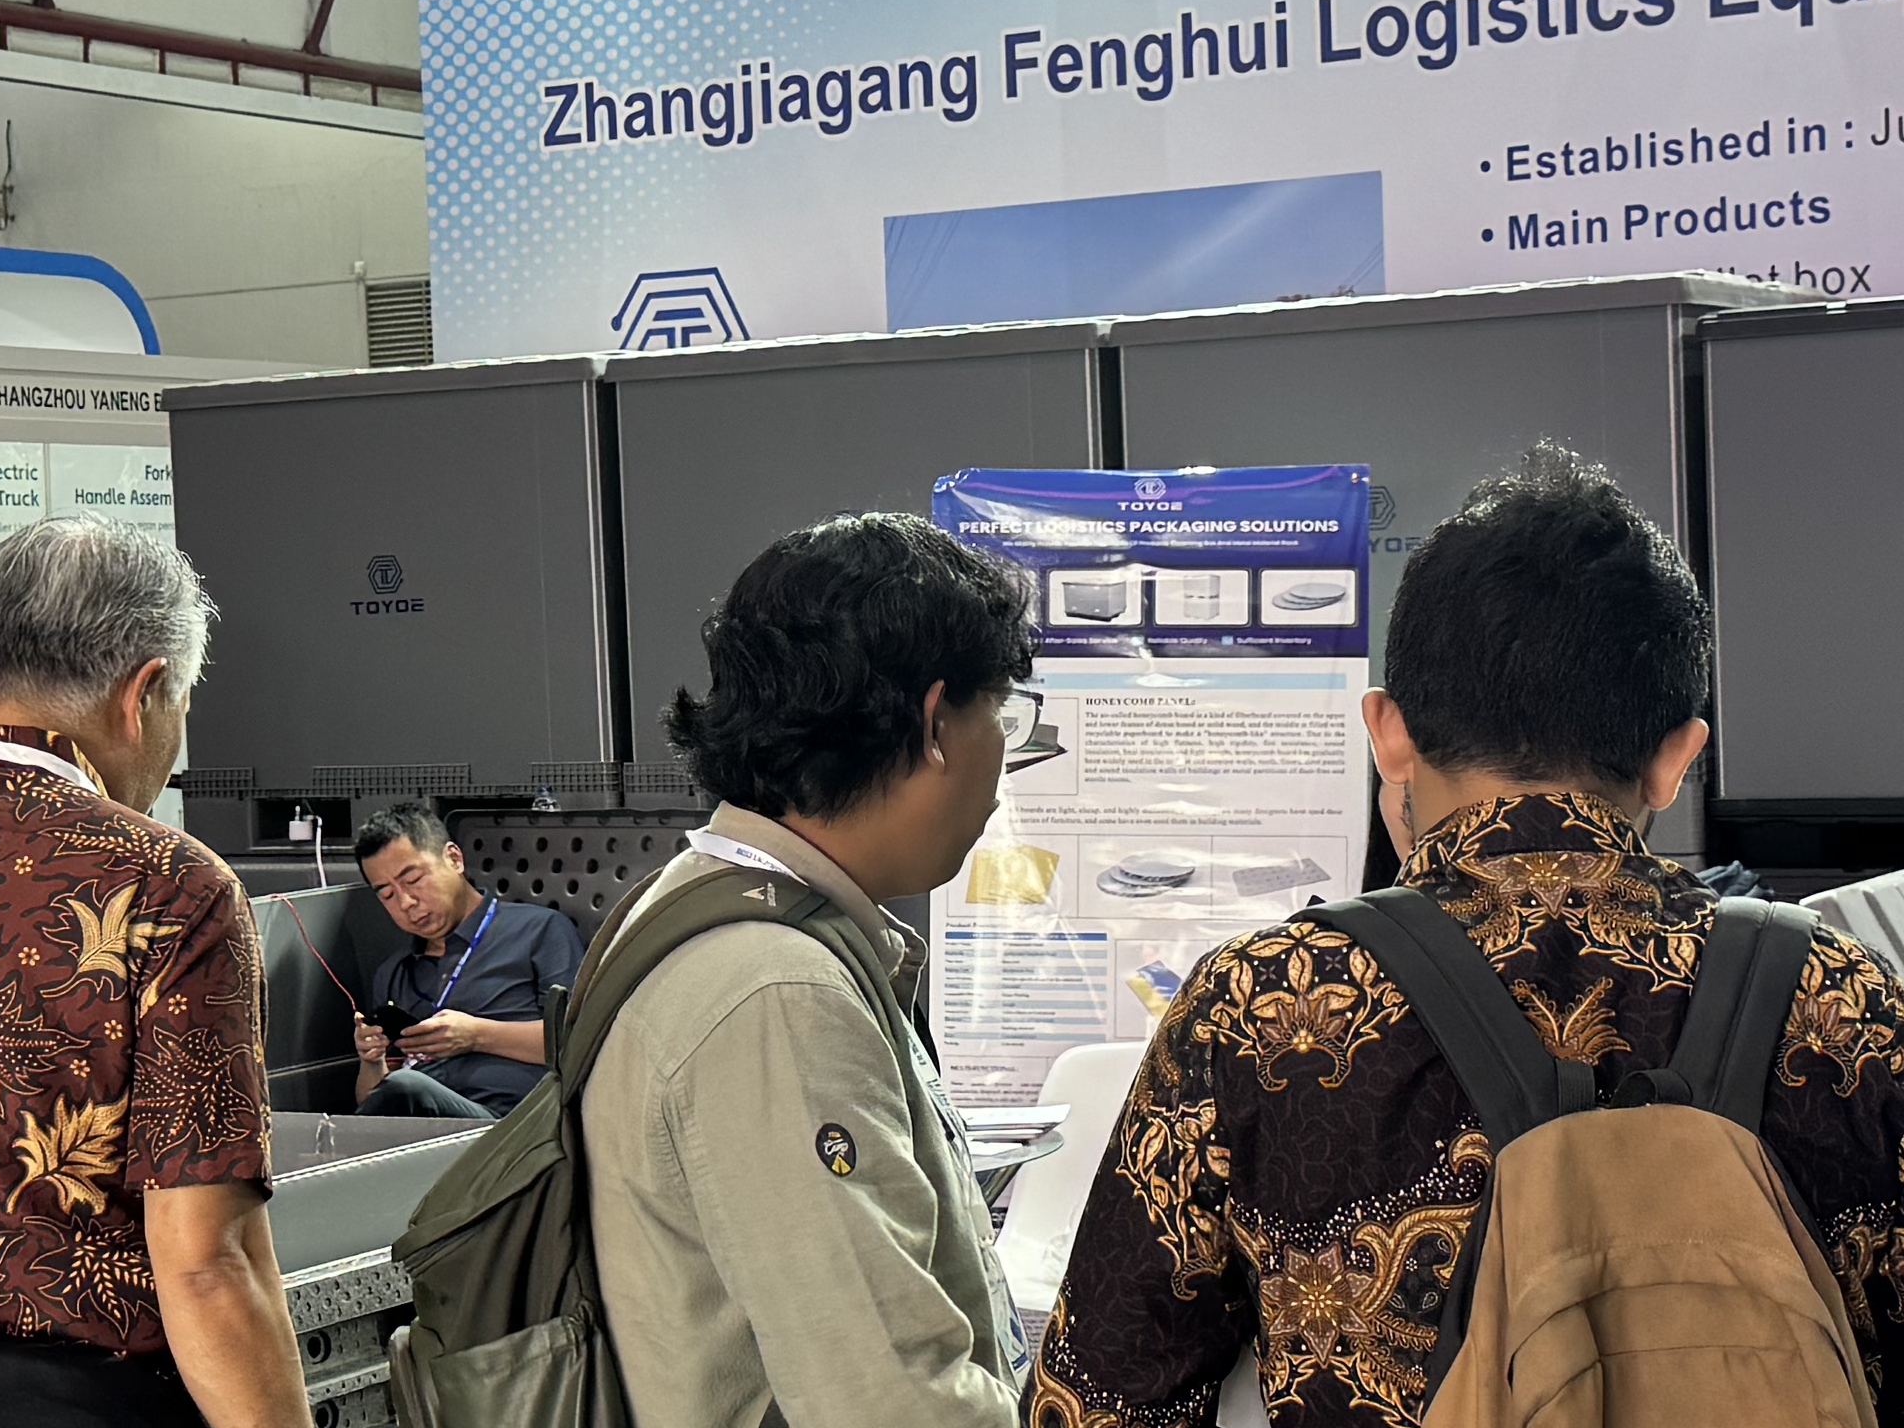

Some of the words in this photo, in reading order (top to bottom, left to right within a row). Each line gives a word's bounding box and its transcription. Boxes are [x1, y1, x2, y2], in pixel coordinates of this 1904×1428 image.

[542, 50, 979, 149] Zhangjiagang
[1004, 1, 1288, 102] Fenghui
[1505, 119, 1771, 183] Established
[1786, 115, 1828, 156] in
[1507, 207, 1610, 253] Main
[1622, 187, 1832, 243] Products
[91, 389, 150, 411] YANENG
[75, 489, 125, 505] Handle
[130, 490, 172, 506] Assem
[1118, 501, 1183, 511] TOYOE
[959, 520, 1032, 534] PERFECT
[1036, 520, 1125, 534] LOGISTICS
[1130, 520, 1237, 534] PACKAGING
[1240, 519, 1339, 534] SOLUTIONS
[349, 598, 425, 615] TOYOE
